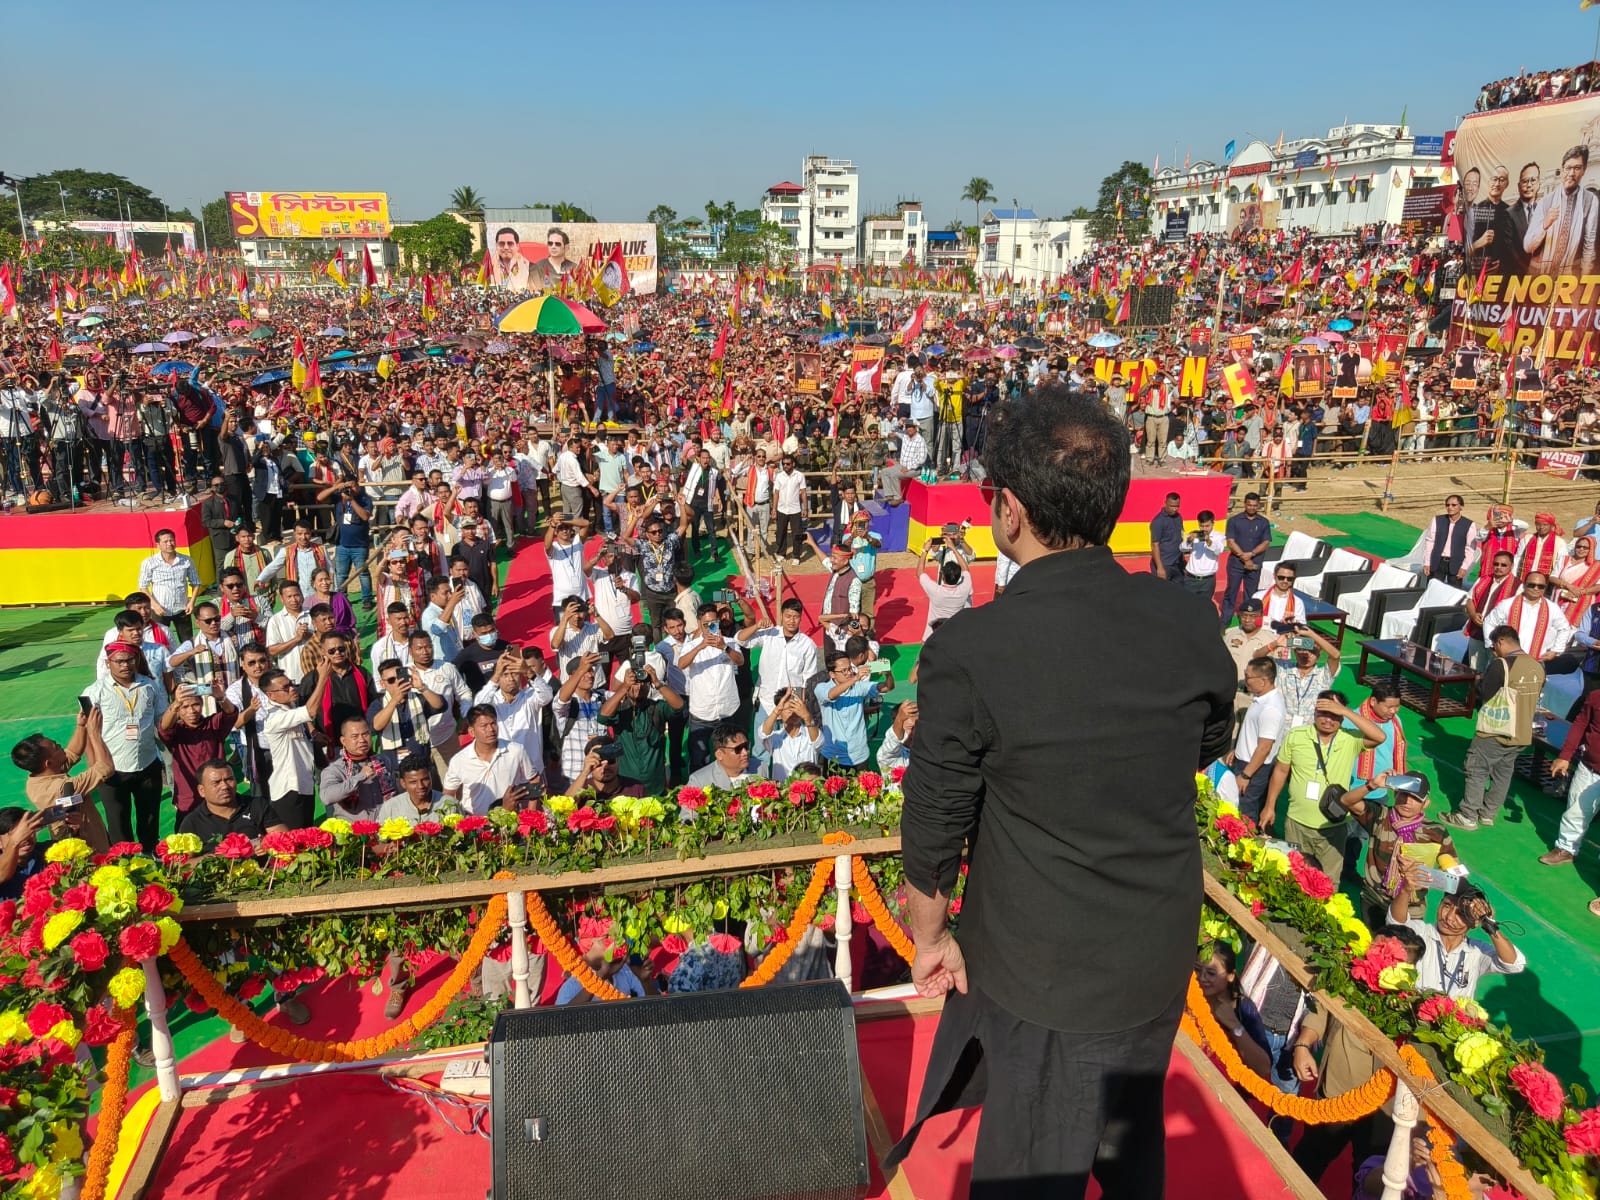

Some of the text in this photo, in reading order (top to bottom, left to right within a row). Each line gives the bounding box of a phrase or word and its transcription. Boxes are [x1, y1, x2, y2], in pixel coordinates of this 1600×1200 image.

[268, 193, 382, 212] সিস্টার
[623, 240, 647, 256] LIVE
[1503, 274, 1600, 305] NORT
[1519, 306, 1588, 328] UNTY
[1512, 327, 1600, 361] RALL
[1541, 451, 1581, 465] WATER
